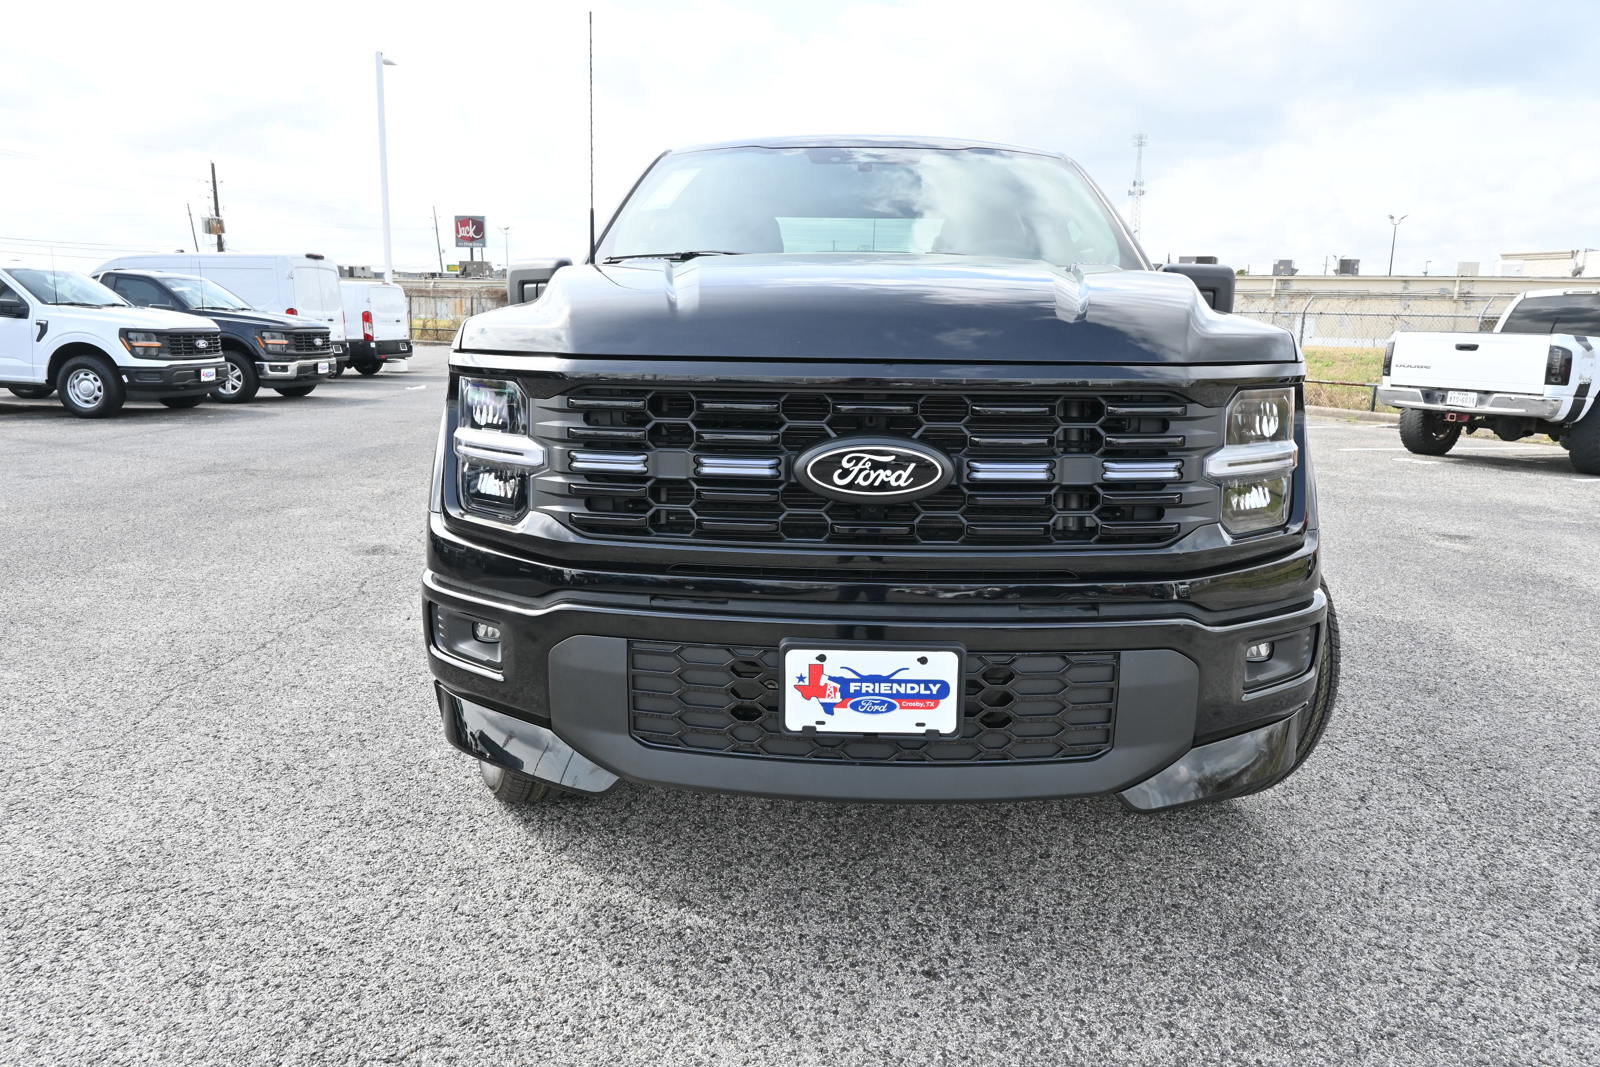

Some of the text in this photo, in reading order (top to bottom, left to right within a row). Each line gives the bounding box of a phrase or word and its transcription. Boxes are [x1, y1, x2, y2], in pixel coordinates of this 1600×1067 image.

[457, 220, 483, 238] Jack
[833, 453, 916, 487] Ford
[849, 682, 941, 695] FRIENDLY
[858, 699, 888, 713] Ford
